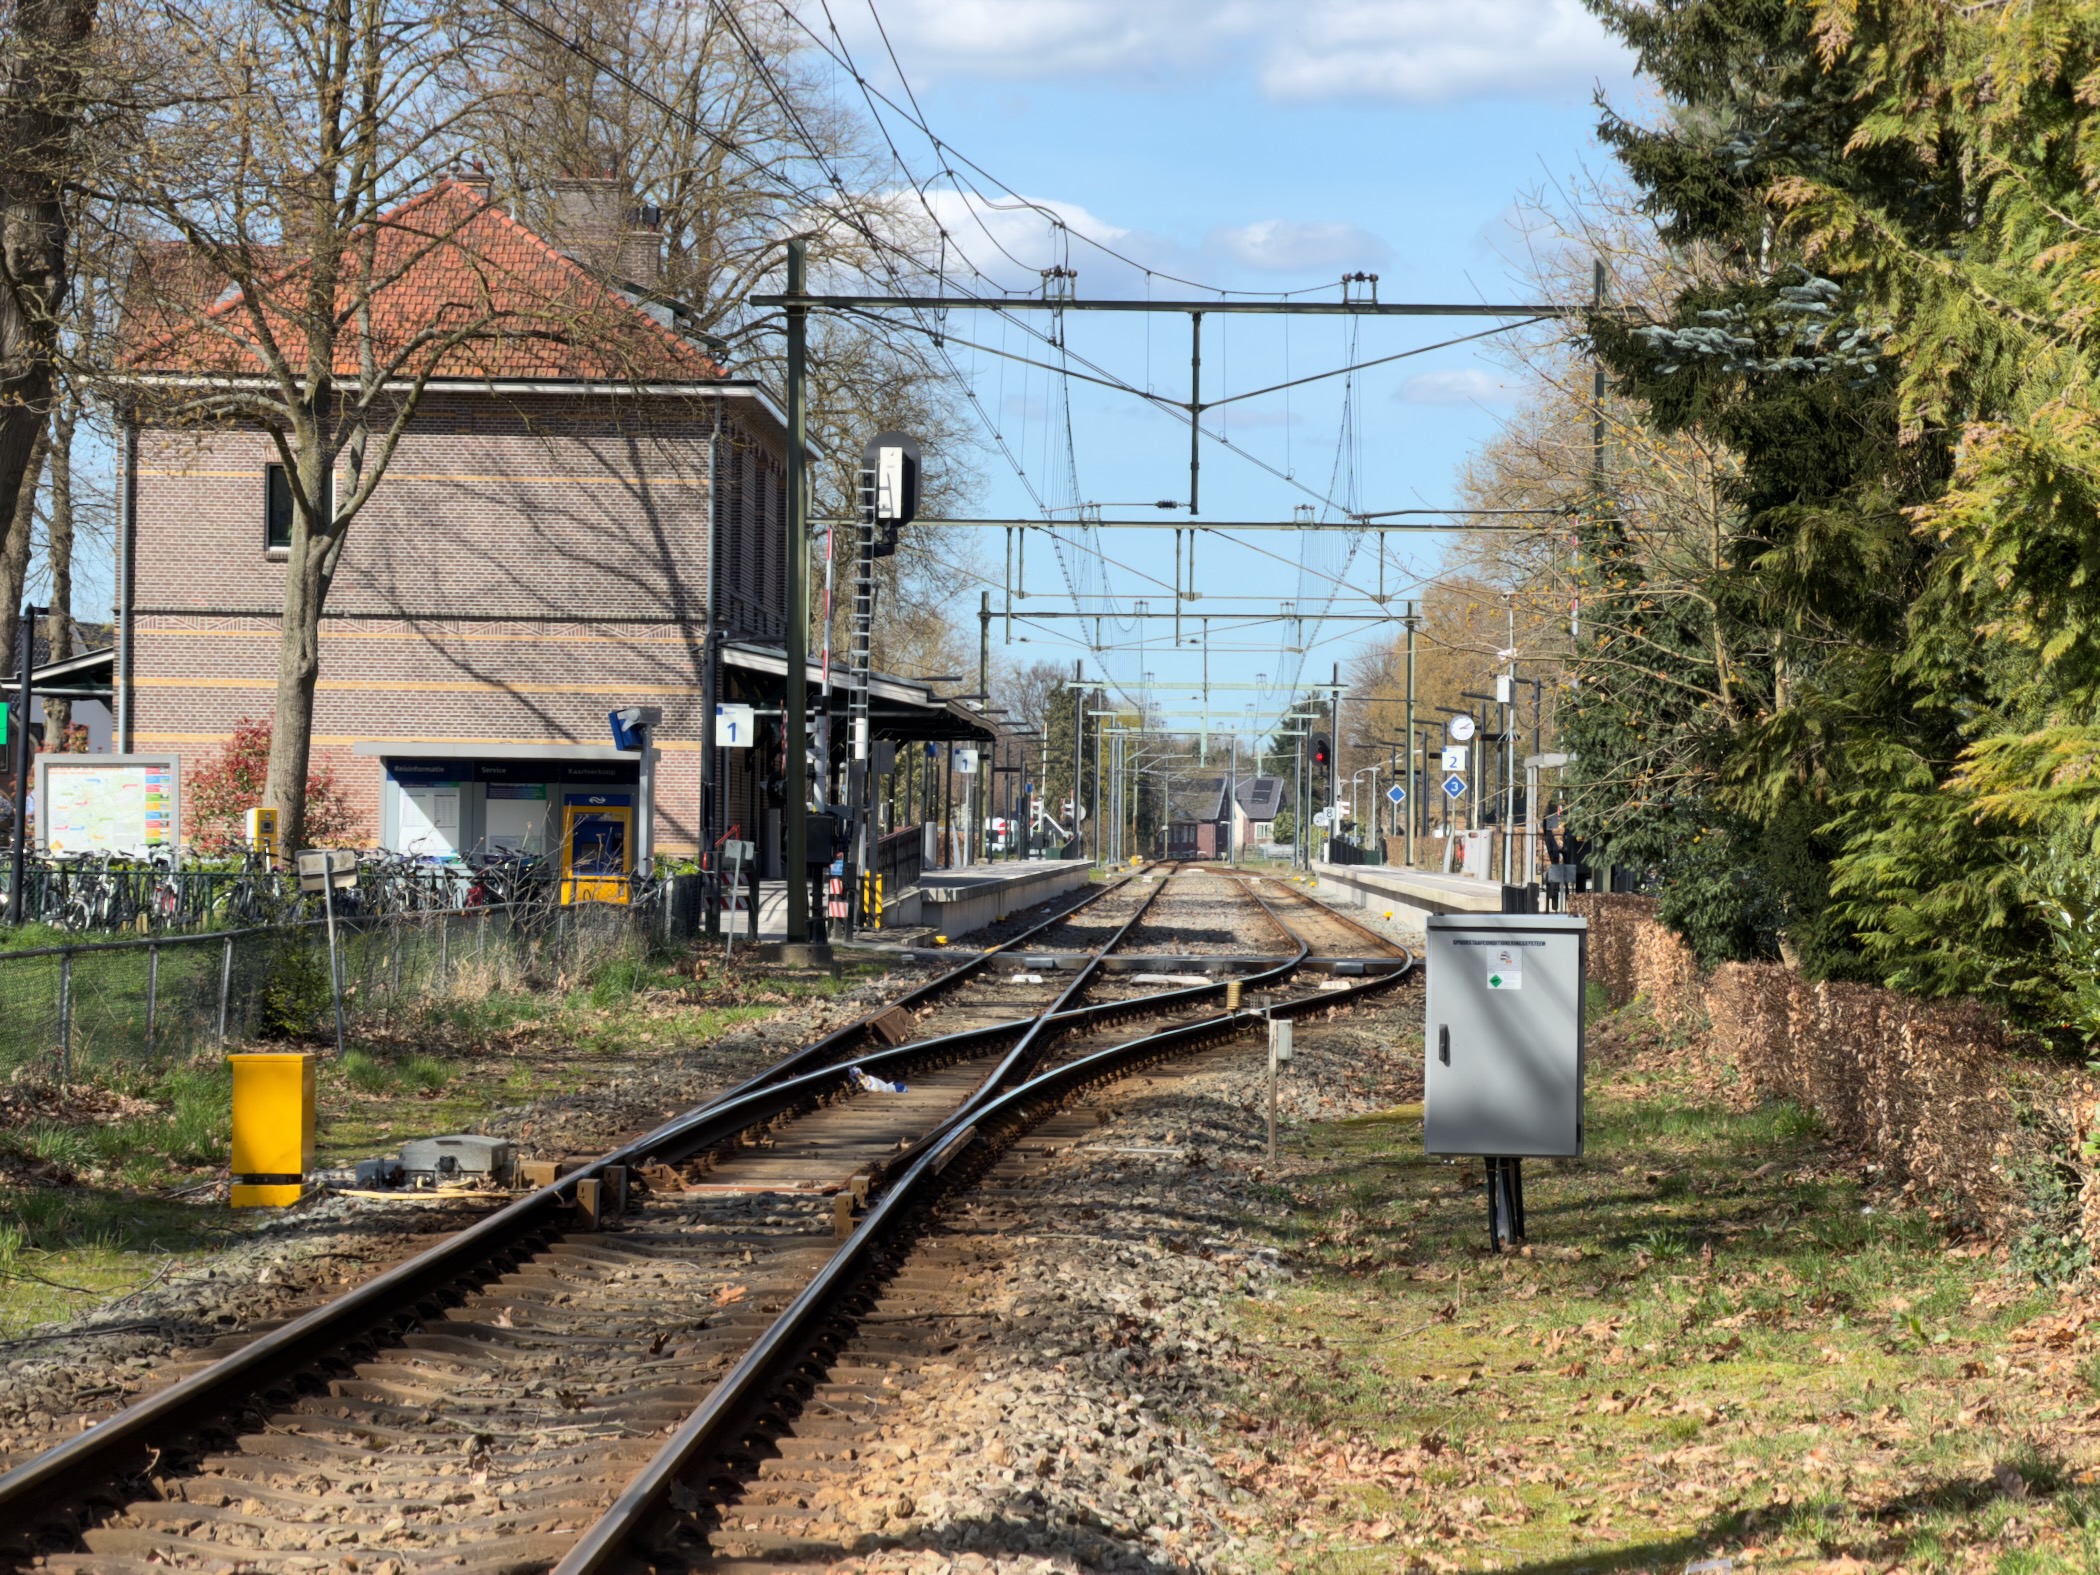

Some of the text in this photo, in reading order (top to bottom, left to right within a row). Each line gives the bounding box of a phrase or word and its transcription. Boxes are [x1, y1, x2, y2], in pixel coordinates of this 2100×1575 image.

[727, 722, 737, 743] 1
[962, 758, 969, 771] 1
[1449, 756, 1458, 769] 2
[394, 765, 445, 773] Reisinformatie
[481, 766, 507, 774] Service
[567, 767, 616, 776] Kaartverkoop
[1450, 781, 1459, 792] 3
[1326, 808, 1333, 818] 8
